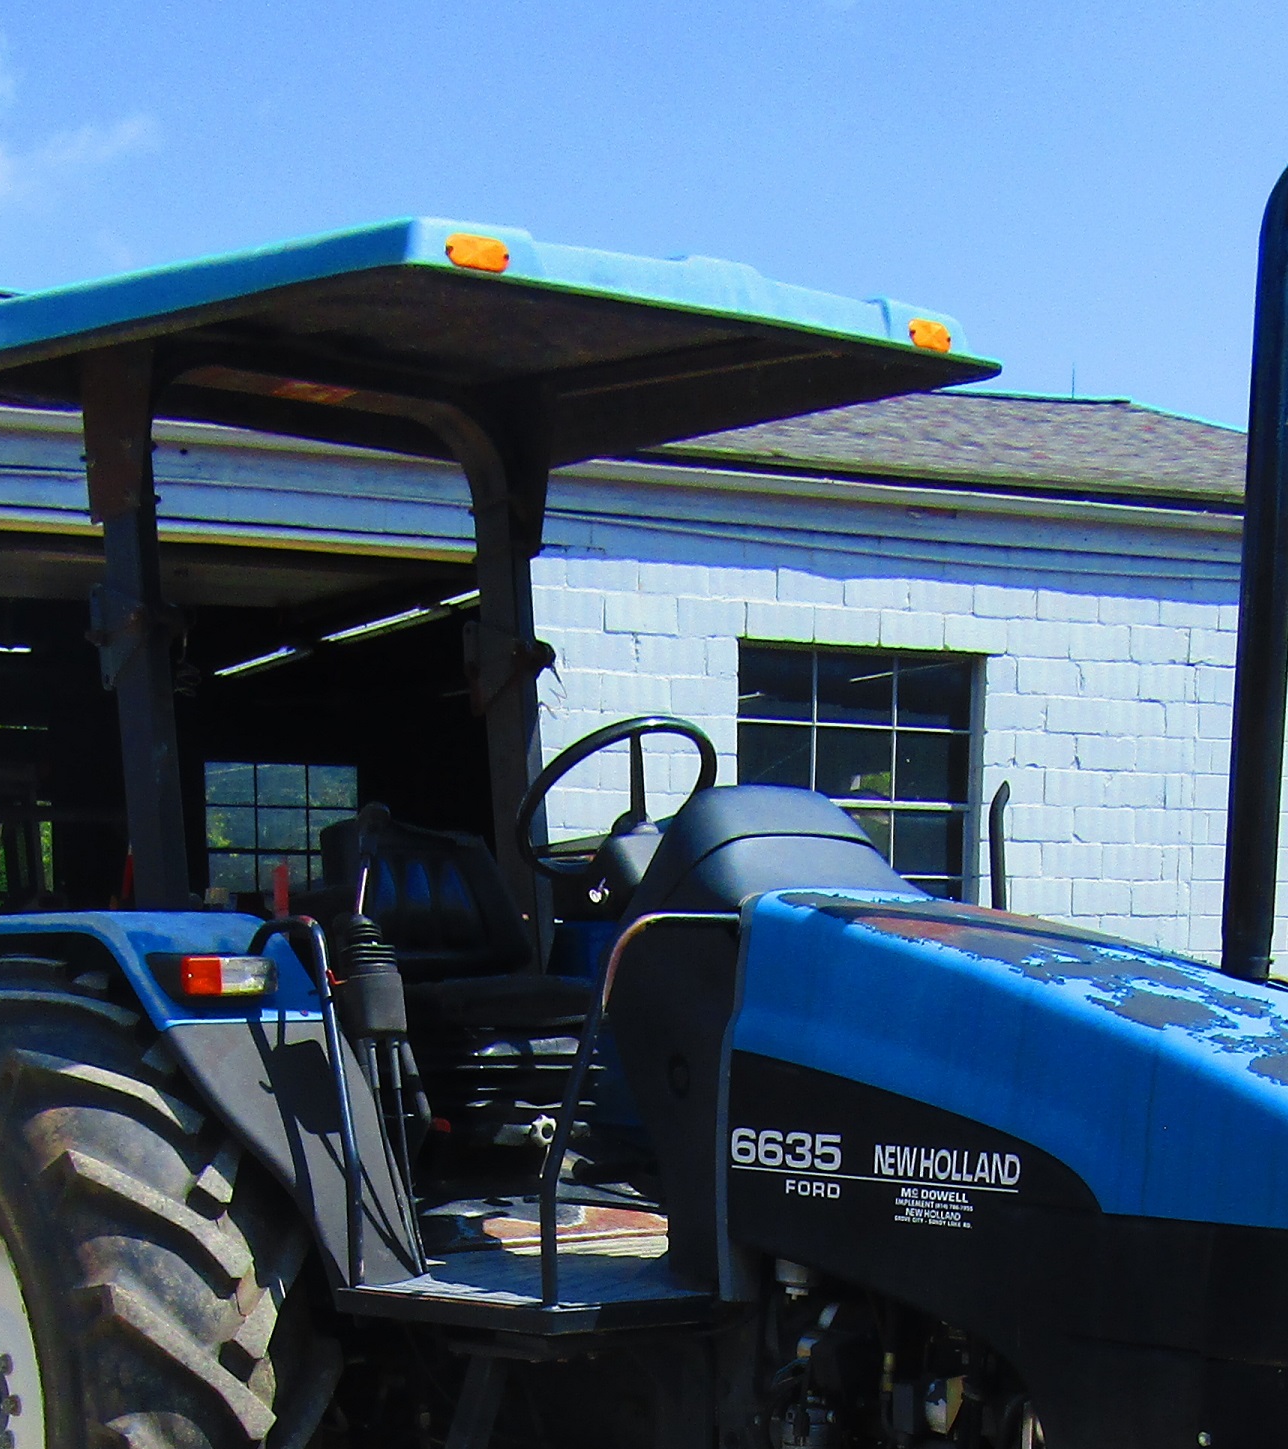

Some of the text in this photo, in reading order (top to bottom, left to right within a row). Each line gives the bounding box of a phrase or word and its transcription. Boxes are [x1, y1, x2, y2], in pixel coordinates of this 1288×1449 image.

[730, 1126, 843, 1172] 6635
[873, 1143, 1022, 1187] NEW HOLLAND
[785, 1178, 842, 1200] FORD
[920, 1189, 970, 1203] DOWELL
[895, 1197, 934, 1209] IMPLEMENT
[905, 1206, 962, 1221] NEW HOLLAND
